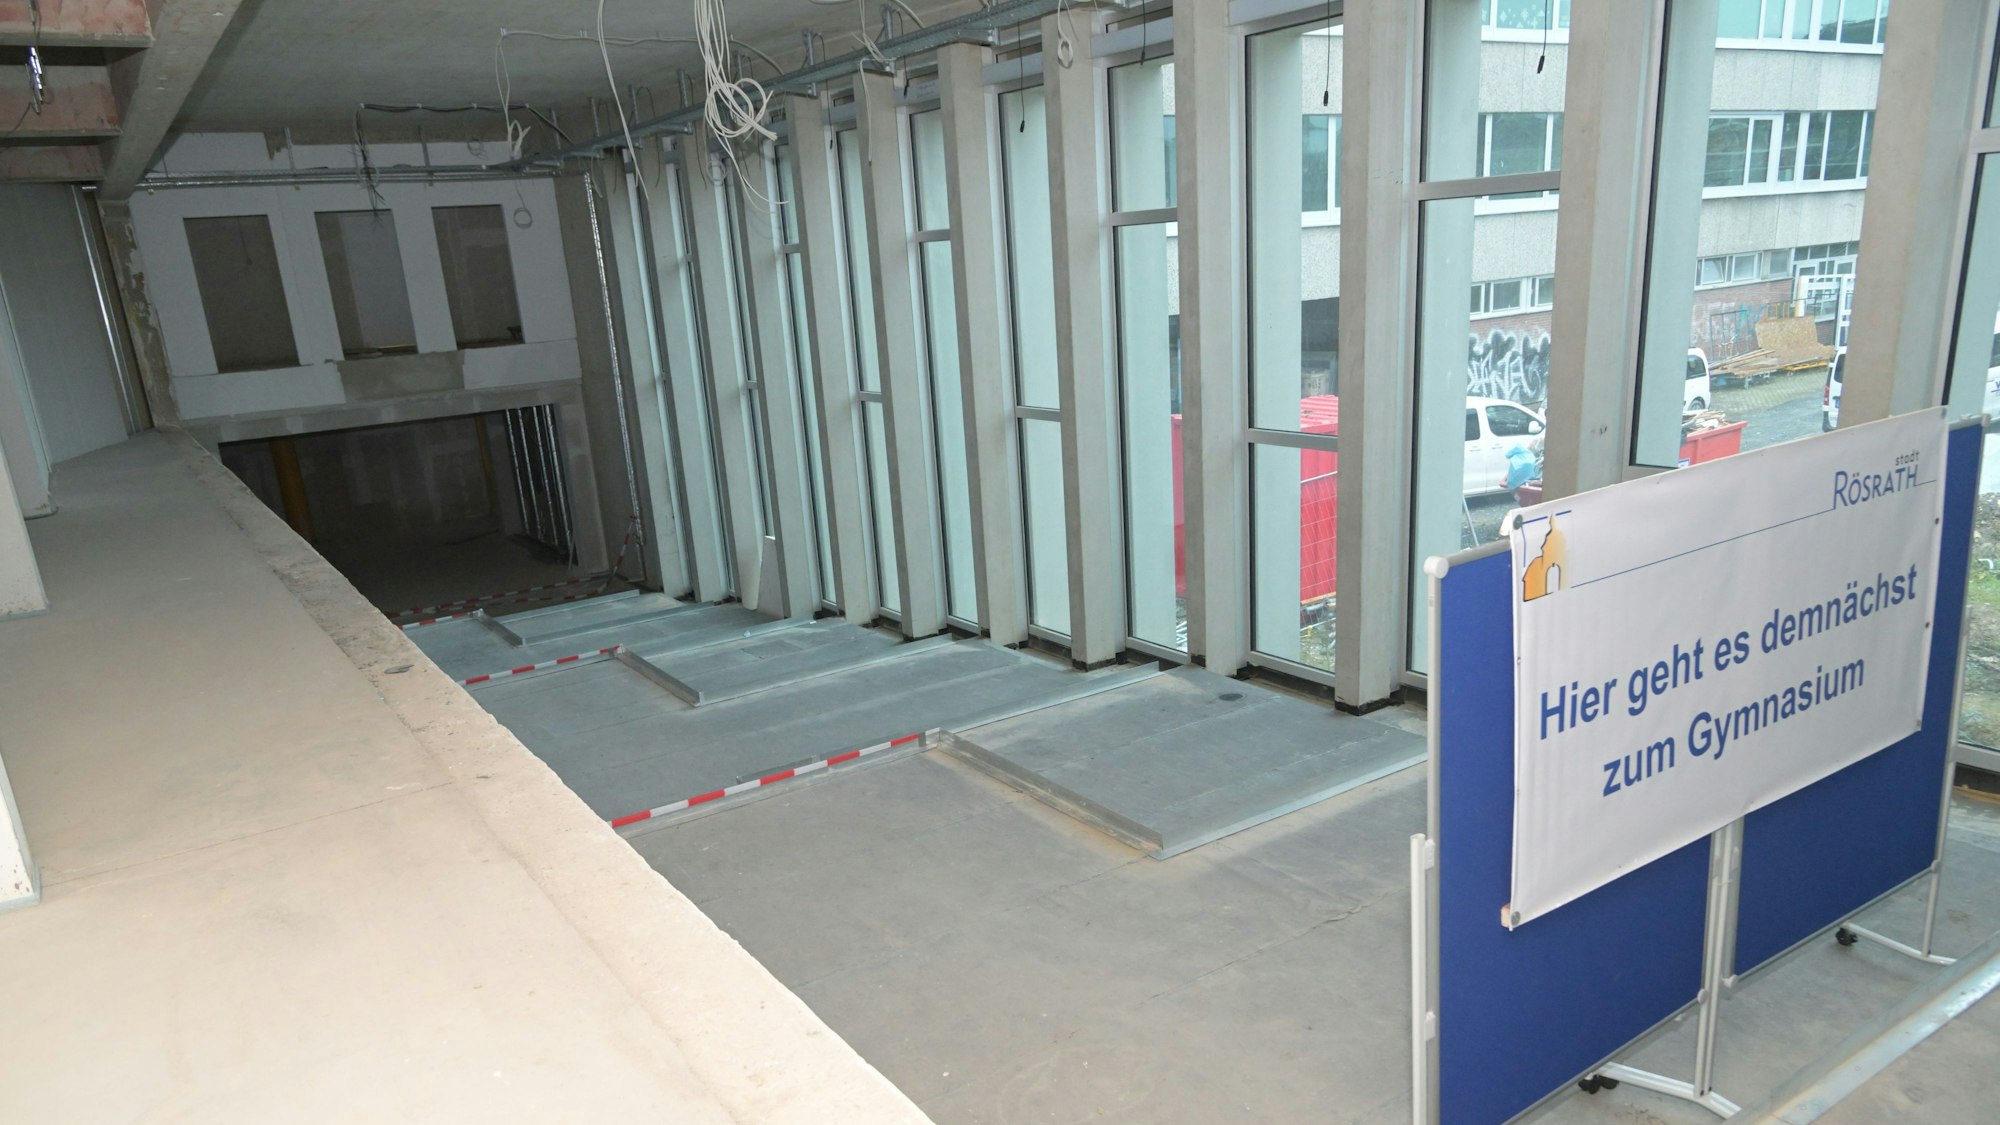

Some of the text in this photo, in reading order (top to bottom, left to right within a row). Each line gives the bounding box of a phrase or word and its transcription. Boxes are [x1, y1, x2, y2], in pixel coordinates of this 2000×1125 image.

[1833, 464, 1919, 509] RÖSRATH
[1895, 450, 1920, 466] stadt
[1540, 563, 1918, 740] Hier geht es demnächst
[1602, 658, 1865, 797] zum Gymnasium
